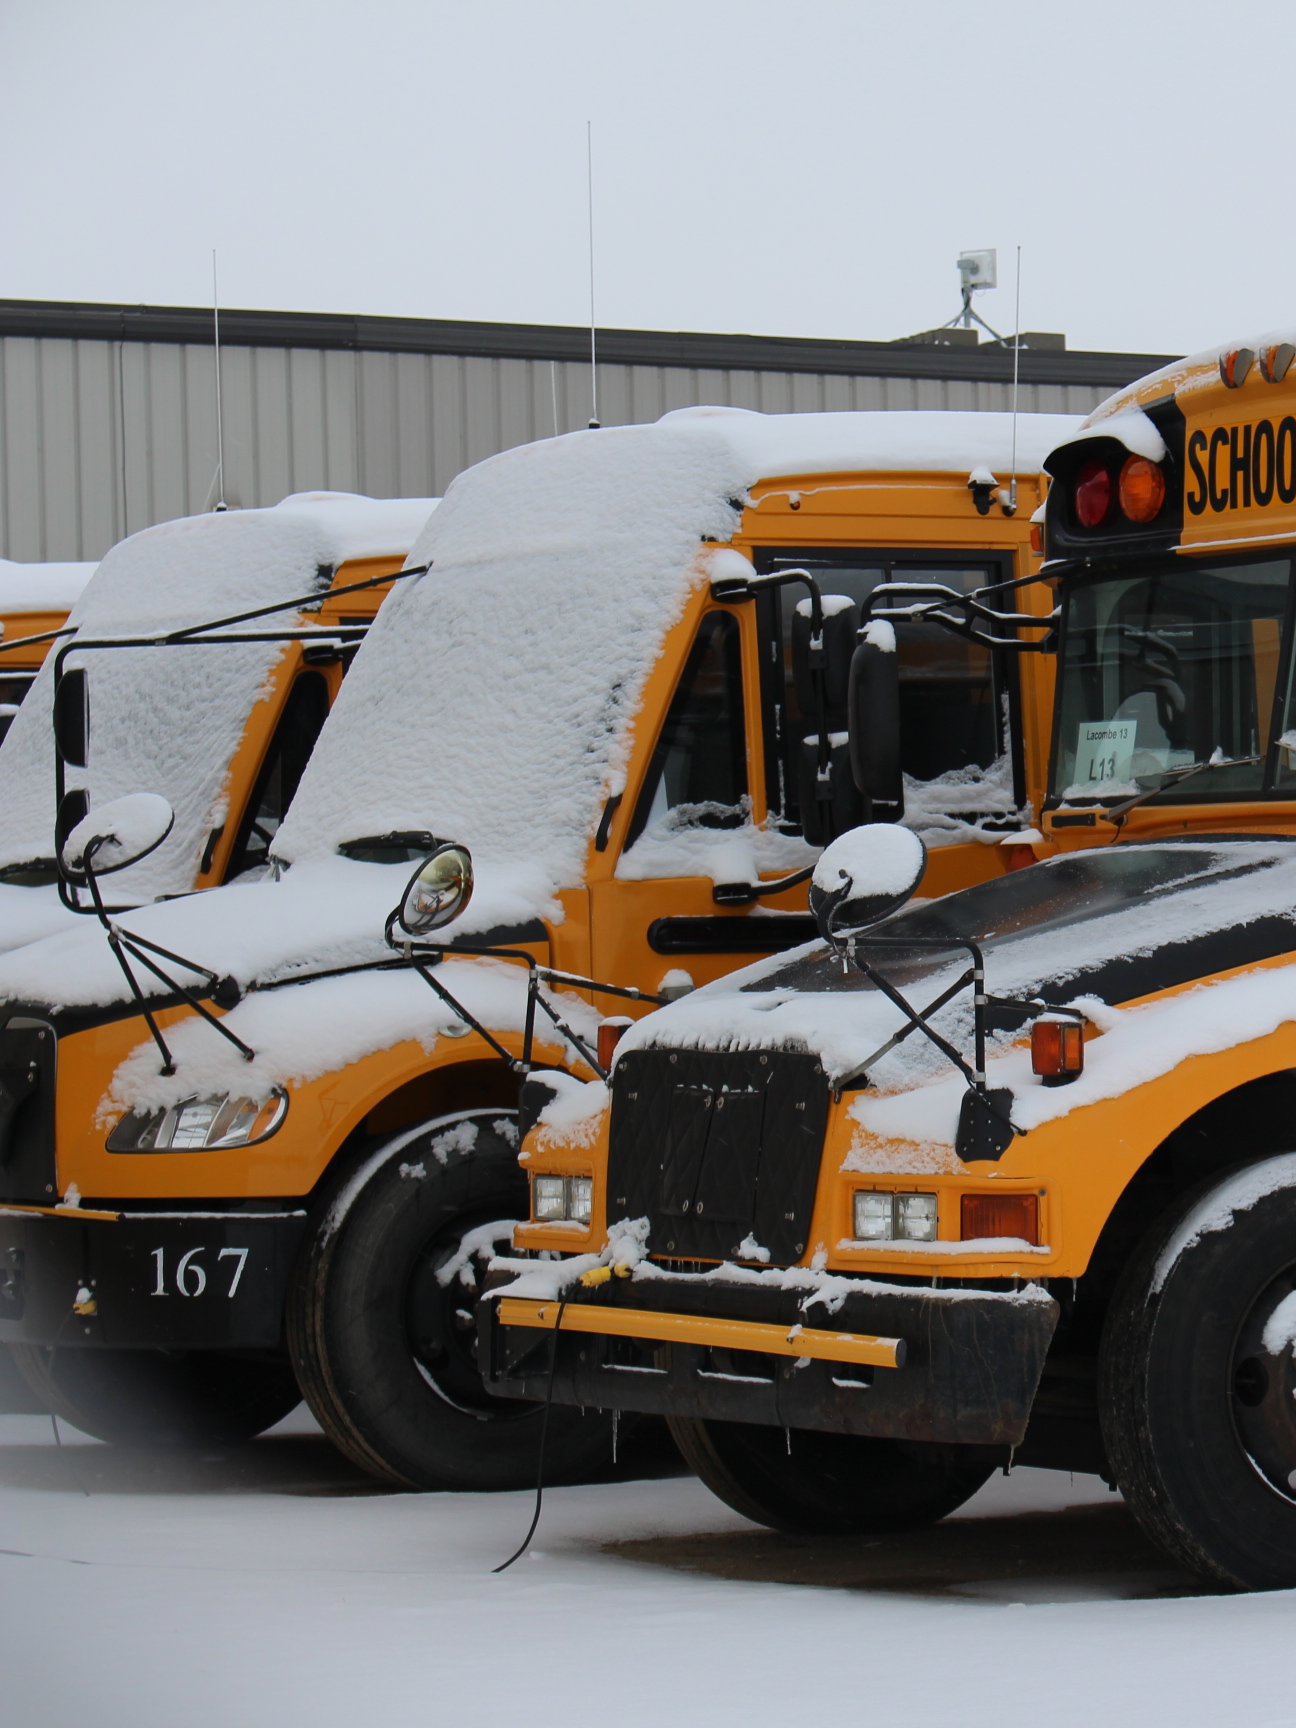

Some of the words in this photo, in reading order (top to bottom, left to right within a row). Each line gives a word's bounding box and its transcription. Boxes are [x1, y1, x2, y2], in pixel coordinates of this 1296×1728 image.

[1086, 729, 1117, 740] Lacombe
[1119, 728, 1128, 739] 13
[1089, 758, 1116, 781] L13
[150, 1246, 249, 1298] 167
